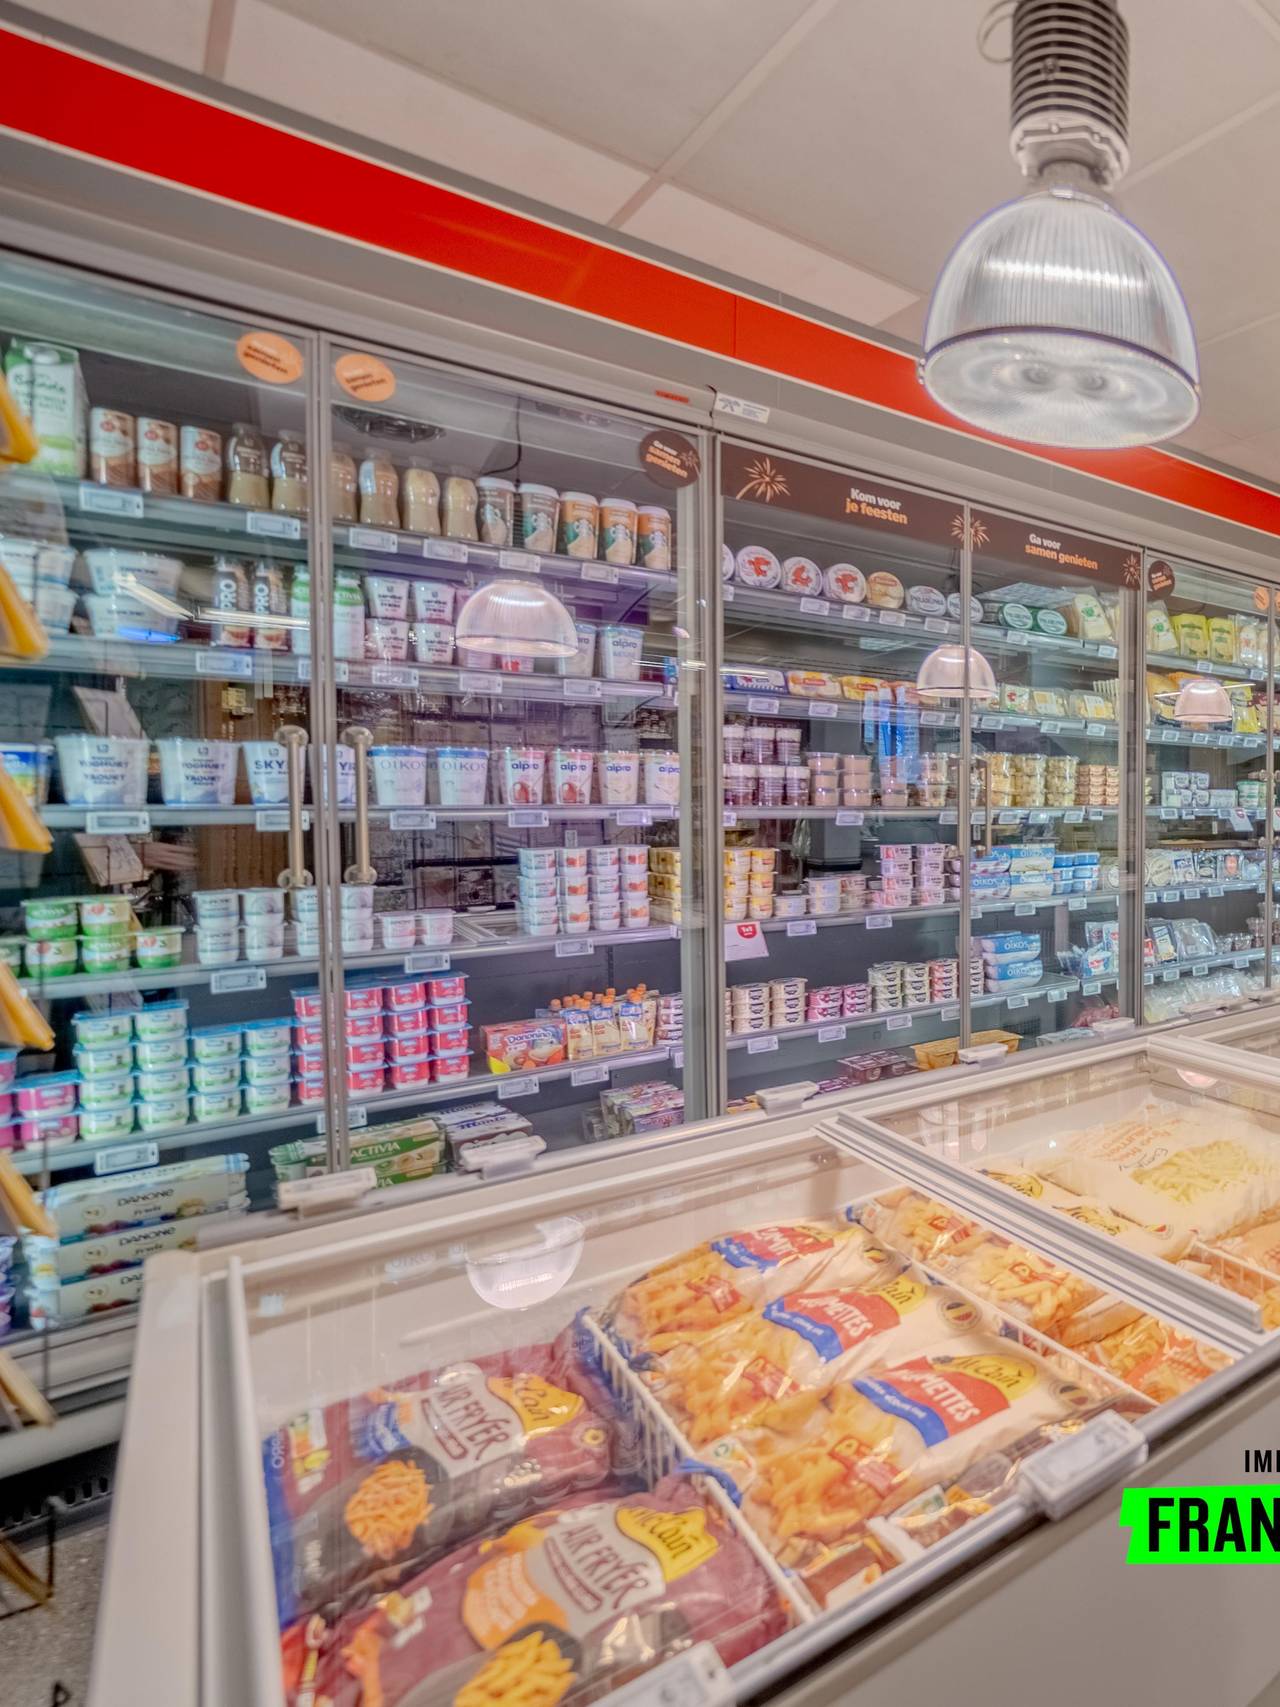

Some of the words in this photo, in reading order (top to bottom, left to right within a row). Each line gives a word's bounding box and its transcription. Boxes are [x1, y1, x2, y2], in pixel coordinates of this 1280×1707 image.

[850, 487, 876, 505] Kom
[877, 496, 902, 510] voor
[845, 497, 859, 513] je
[860, 502, 908, 525] feesten
[1029, 533, 1042, 545] Ga
[1042, 540, 1062, 550] voor
[1025, 543, 1058, 559] samen
[1058, 552, 1099, 570] genieten
[612, 637, 638, 650] alpro
[254, 760, 288, 771] SKY
[511, 761, 540, 772] alpro
[560, 762, 587, 772] alpro
[607, 763, 632, 773] alpro
[506, 1030, 553, 1044] Danonino
[351, 1141, 400, 1158] ACTIVIA
[117, 1189, 174, 1206] DANONE
[119, 1227, 176, 1246] DANONE
[450, 1401, 511, 1461] FRYER
[562, 1523, 603, 1552] AIR
[577, 1546, 649, 1611] FRYER
